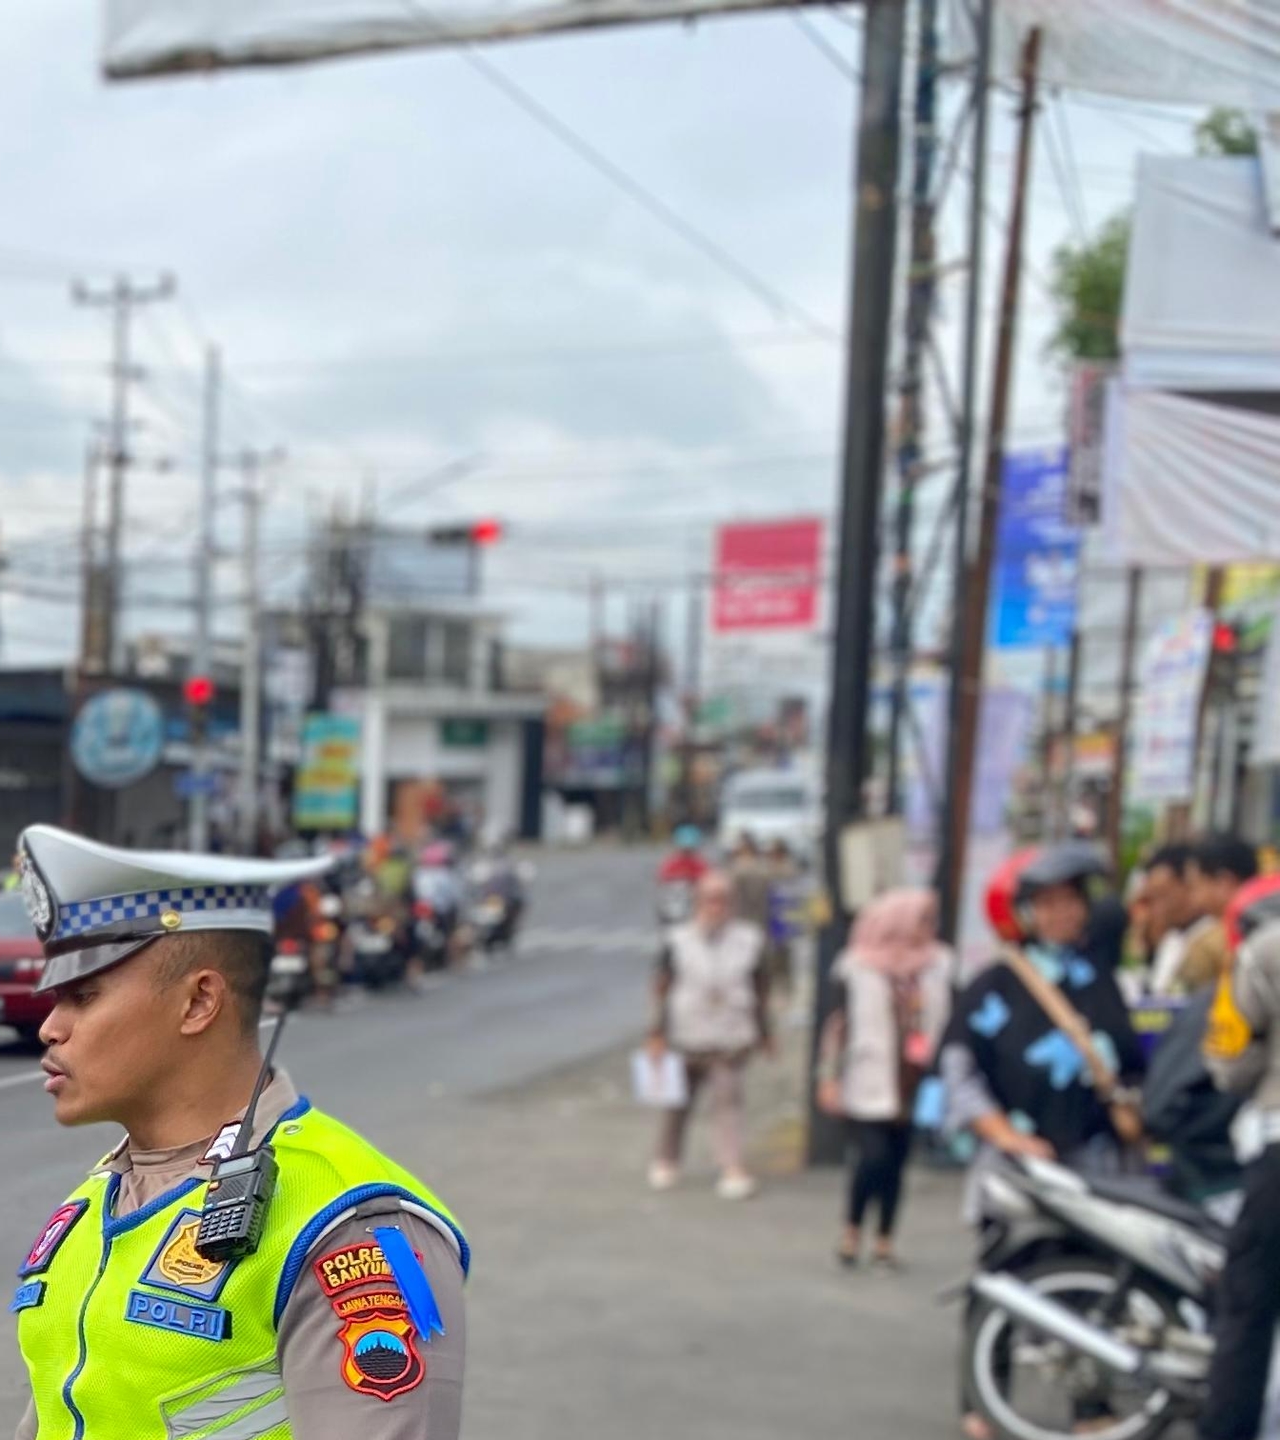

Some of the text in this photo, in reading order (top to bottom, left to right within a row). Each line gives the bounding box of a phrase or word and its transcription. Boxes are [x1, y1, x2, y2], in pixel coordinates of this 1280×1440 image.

[322, 1247, 389, 1276] POLRE
[327, 1260, 394, 1288] BANYUM
[366, 1293, 406, 1308] TENGA
[132, 1296, 218, 1334] POLRI
